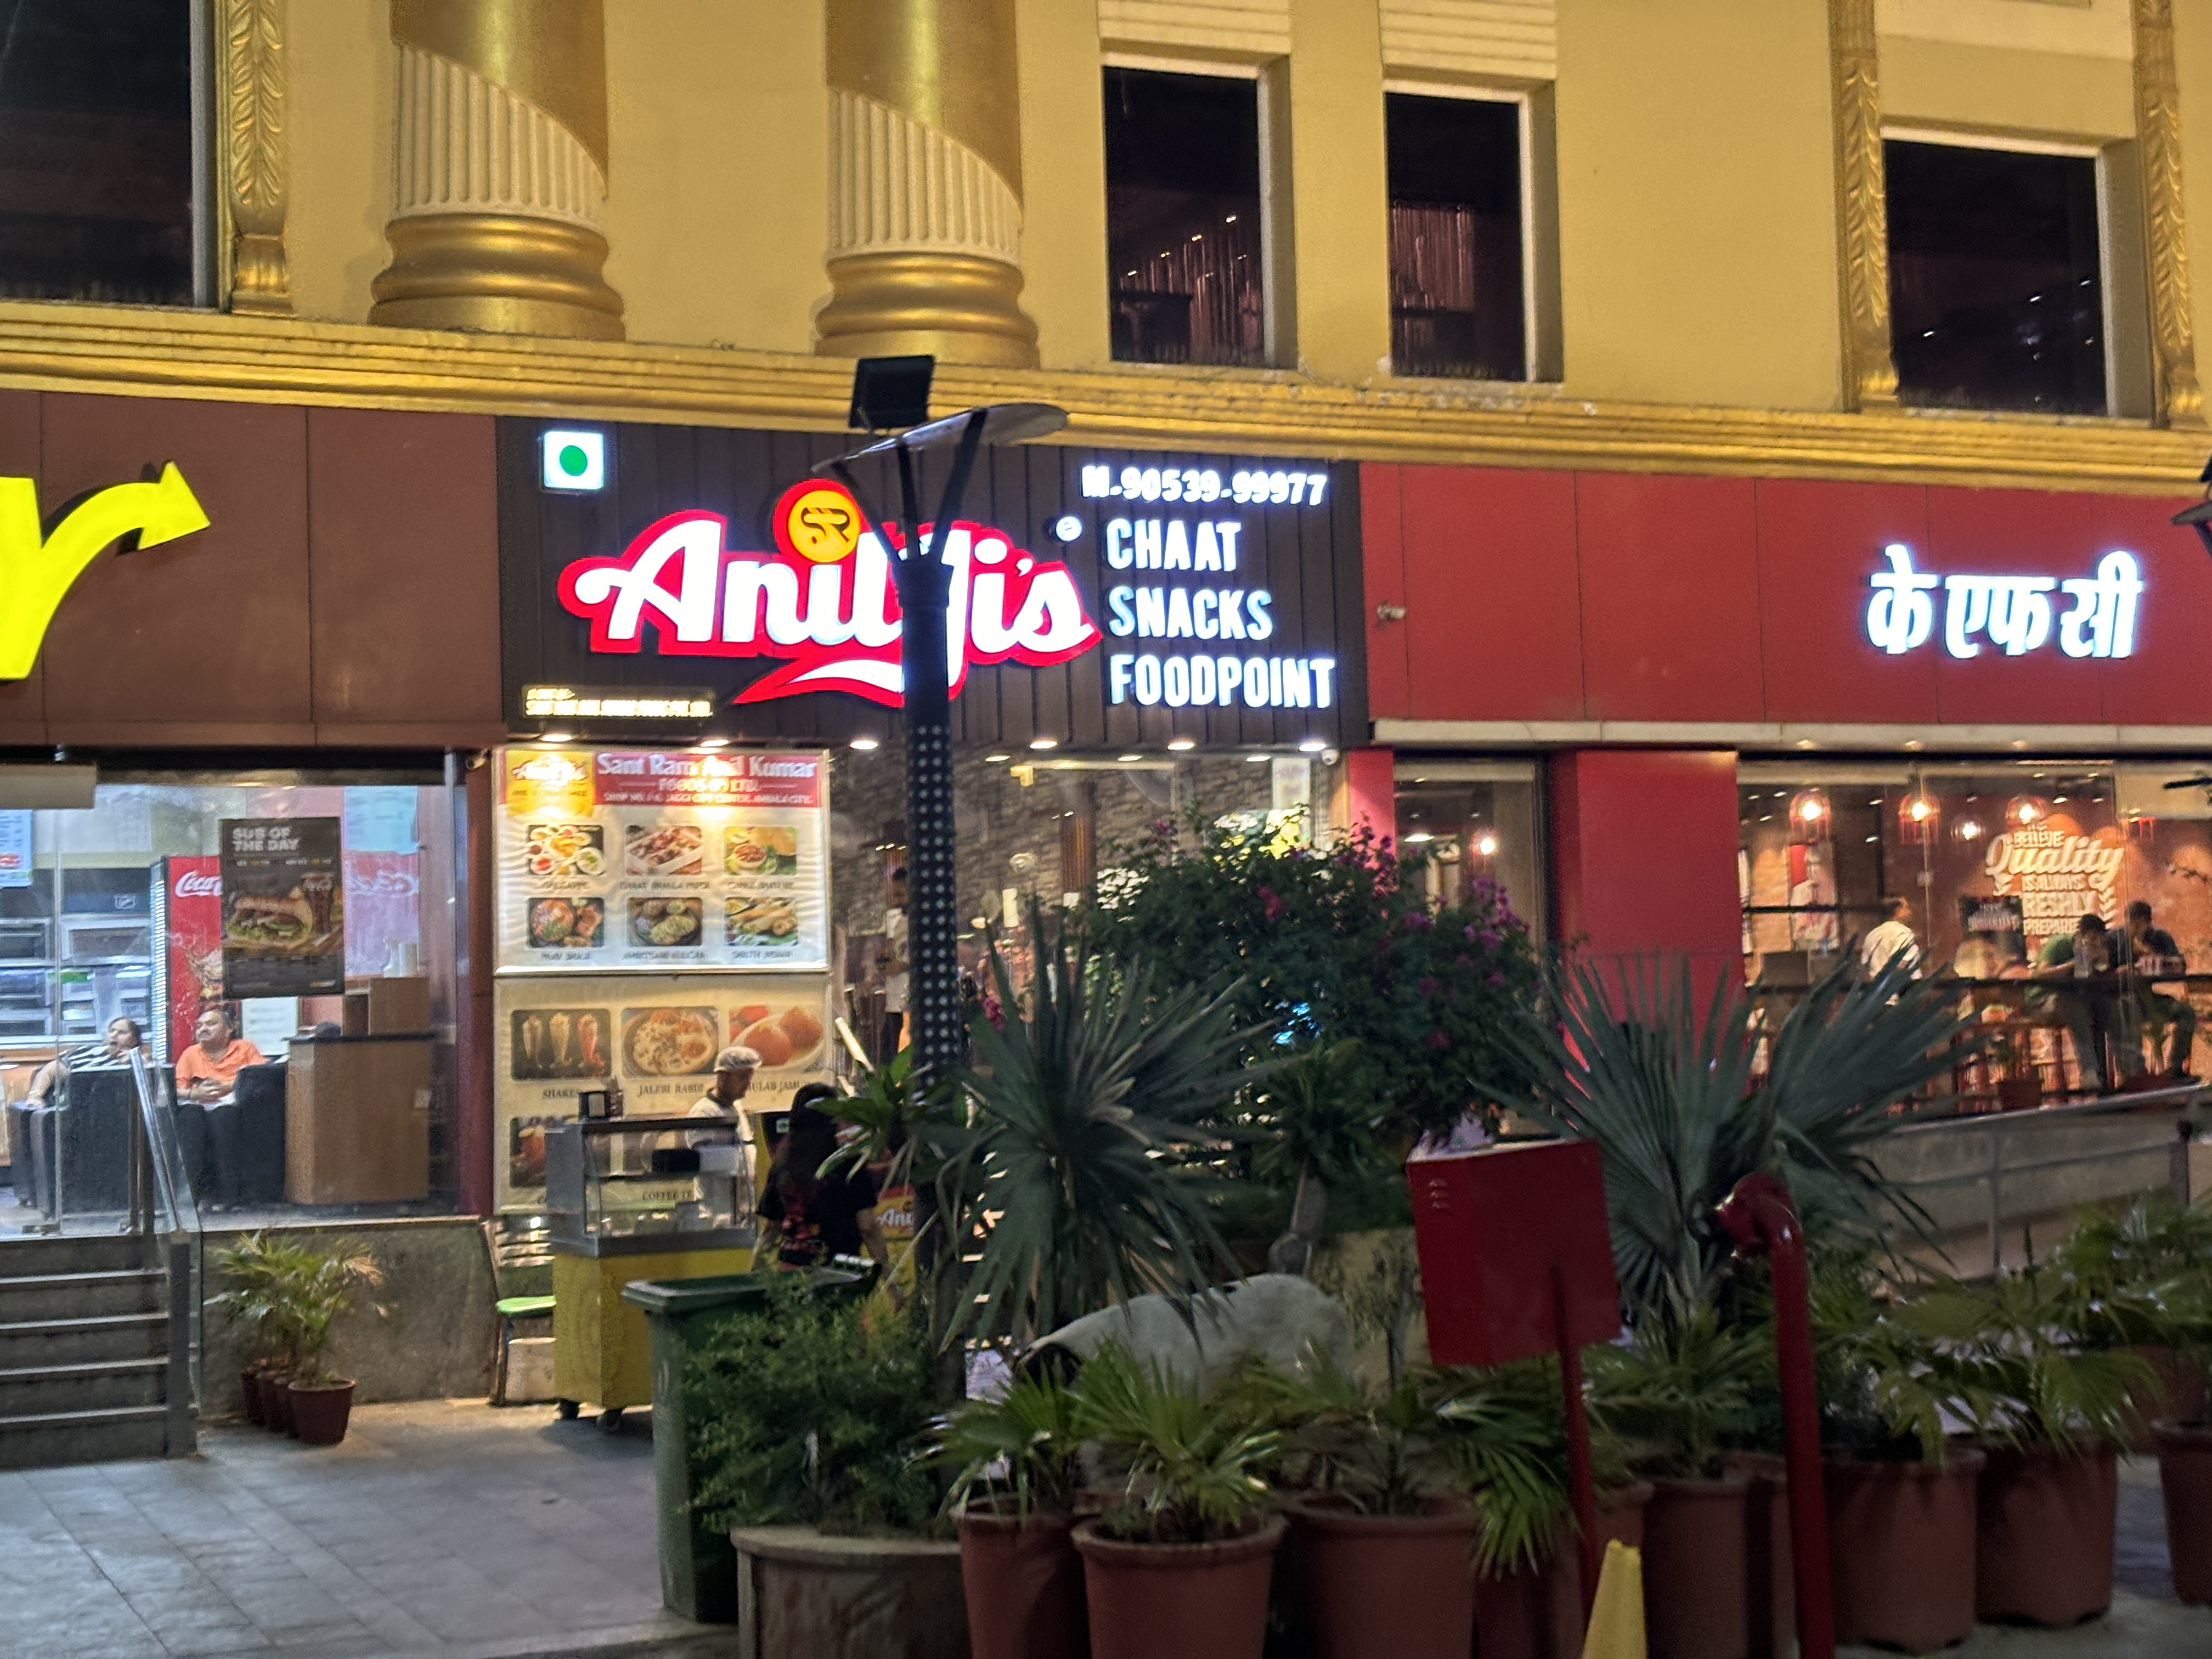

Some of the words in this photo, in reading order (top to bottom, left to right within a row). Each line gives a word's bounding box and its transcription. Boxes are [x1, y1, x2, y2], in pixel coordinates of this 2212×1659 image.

[1105, 518, 1242, 572] CHAAT
[1108, 584, 1274, 641] SNACKS
[1109, 653, 1336, 709] FOODPOINT
[749, 756, 818, 777] Kumar
[232, 840, 264, 852] THE
[268, 837, 300, 851] DAY
[1985, 833, 2125, 889] Quality
[2021, 889, 2097, 917] RESHLY
[2023, 917, 2081, 935] PREPARE
[748, 1081, 776, 1092] ULAB
